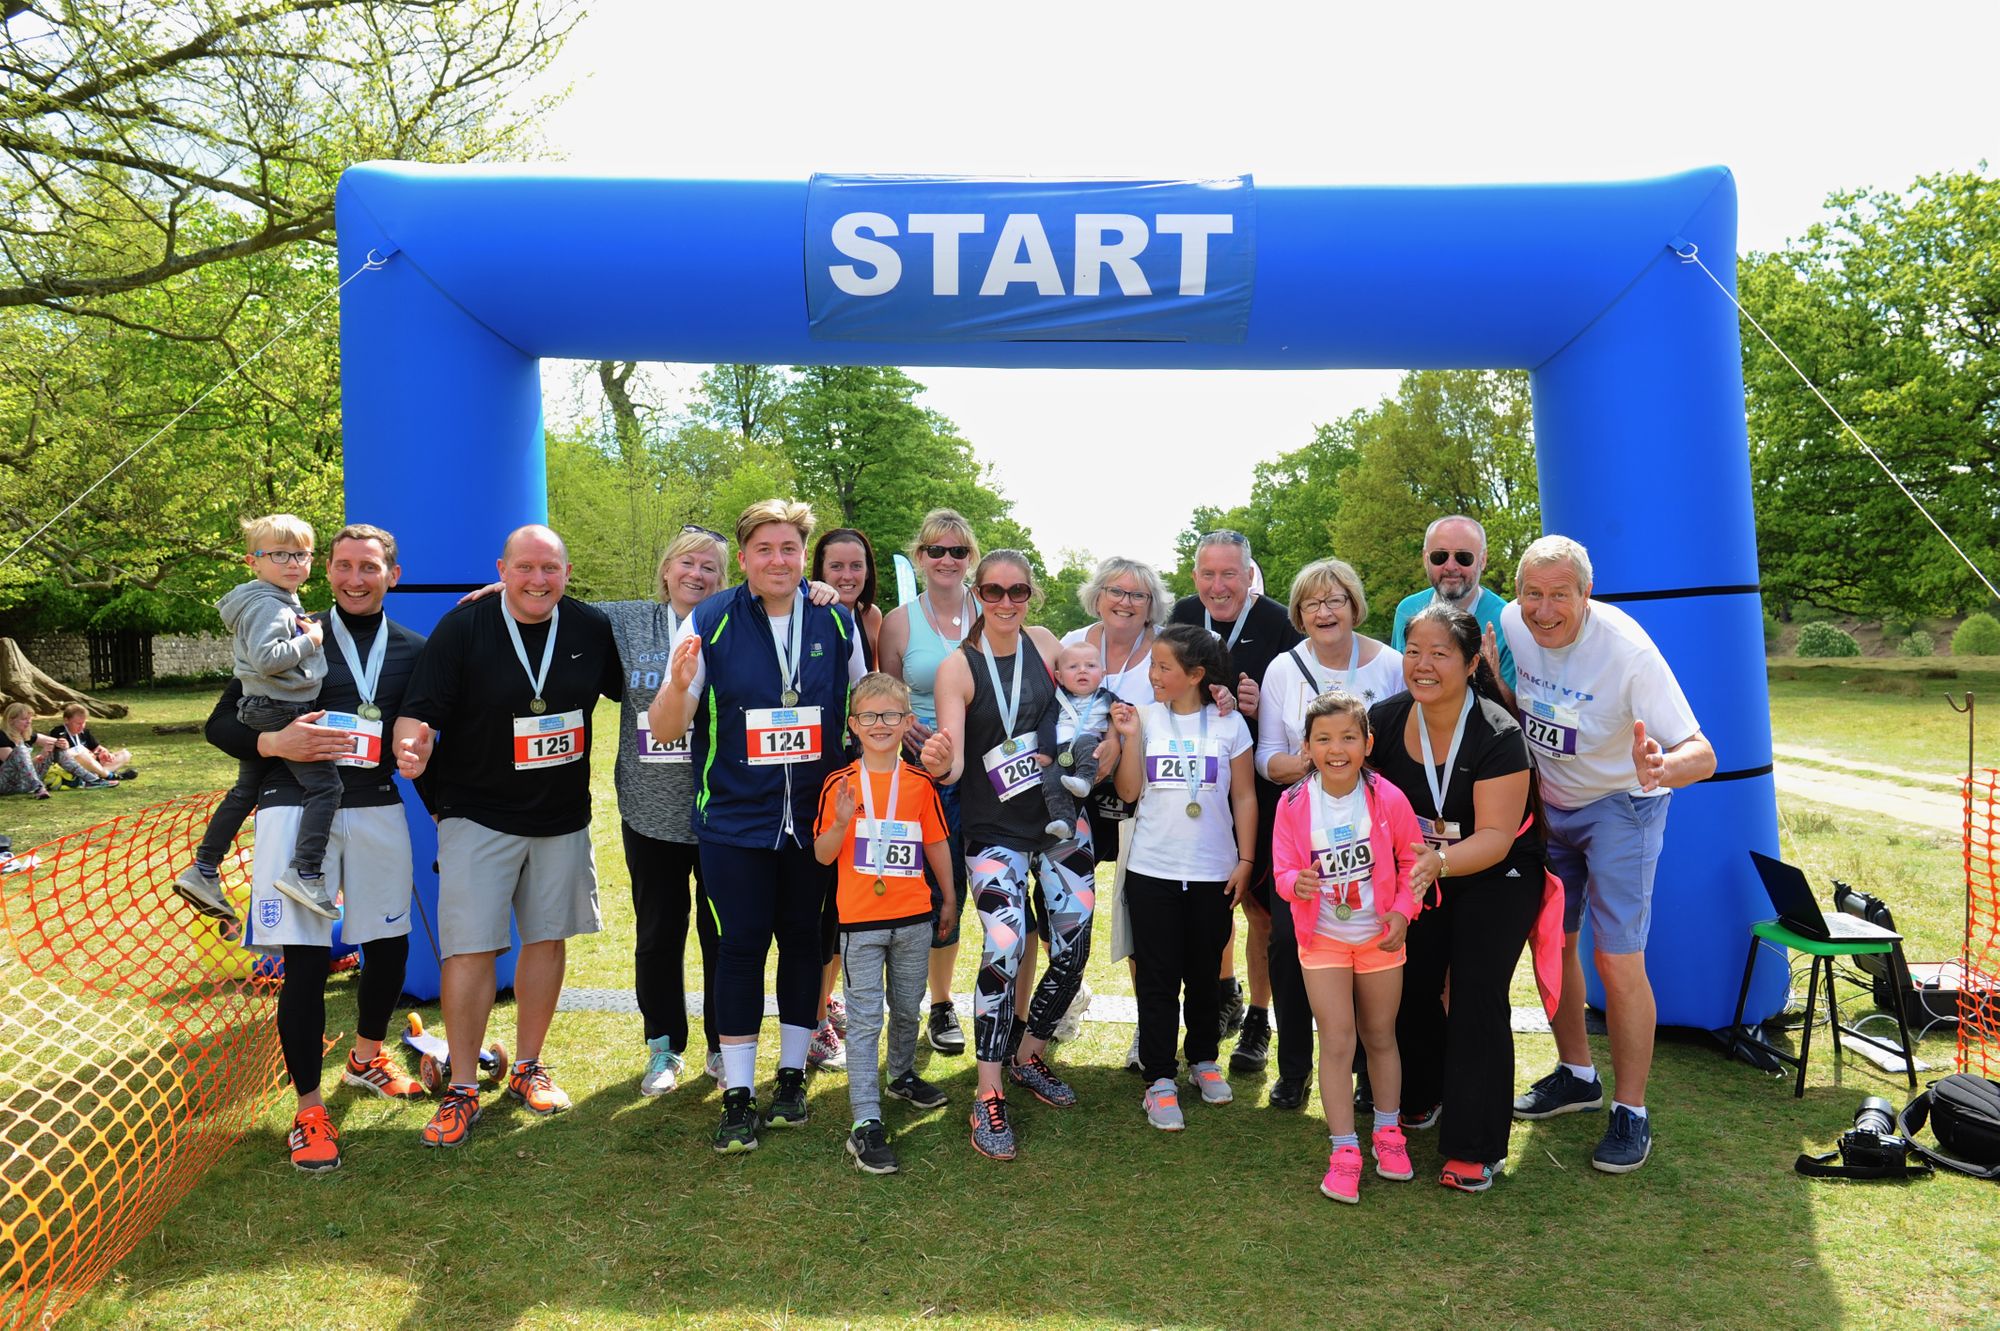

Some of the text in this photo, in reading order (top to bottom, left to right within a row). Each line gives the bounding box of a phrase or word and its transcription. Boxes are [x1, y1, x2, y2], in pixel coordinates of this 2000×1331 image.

[828, 211, 1234, 297] START
[534, 735, 570, 757] 125
[766, 731, 805, 752] 124
[1529, 720, 1558, 747] 274
[1004, 756, 1040, 785] 262
[872, 844, 911, 865] 63
[1326, 844, 1371, 873] 269
